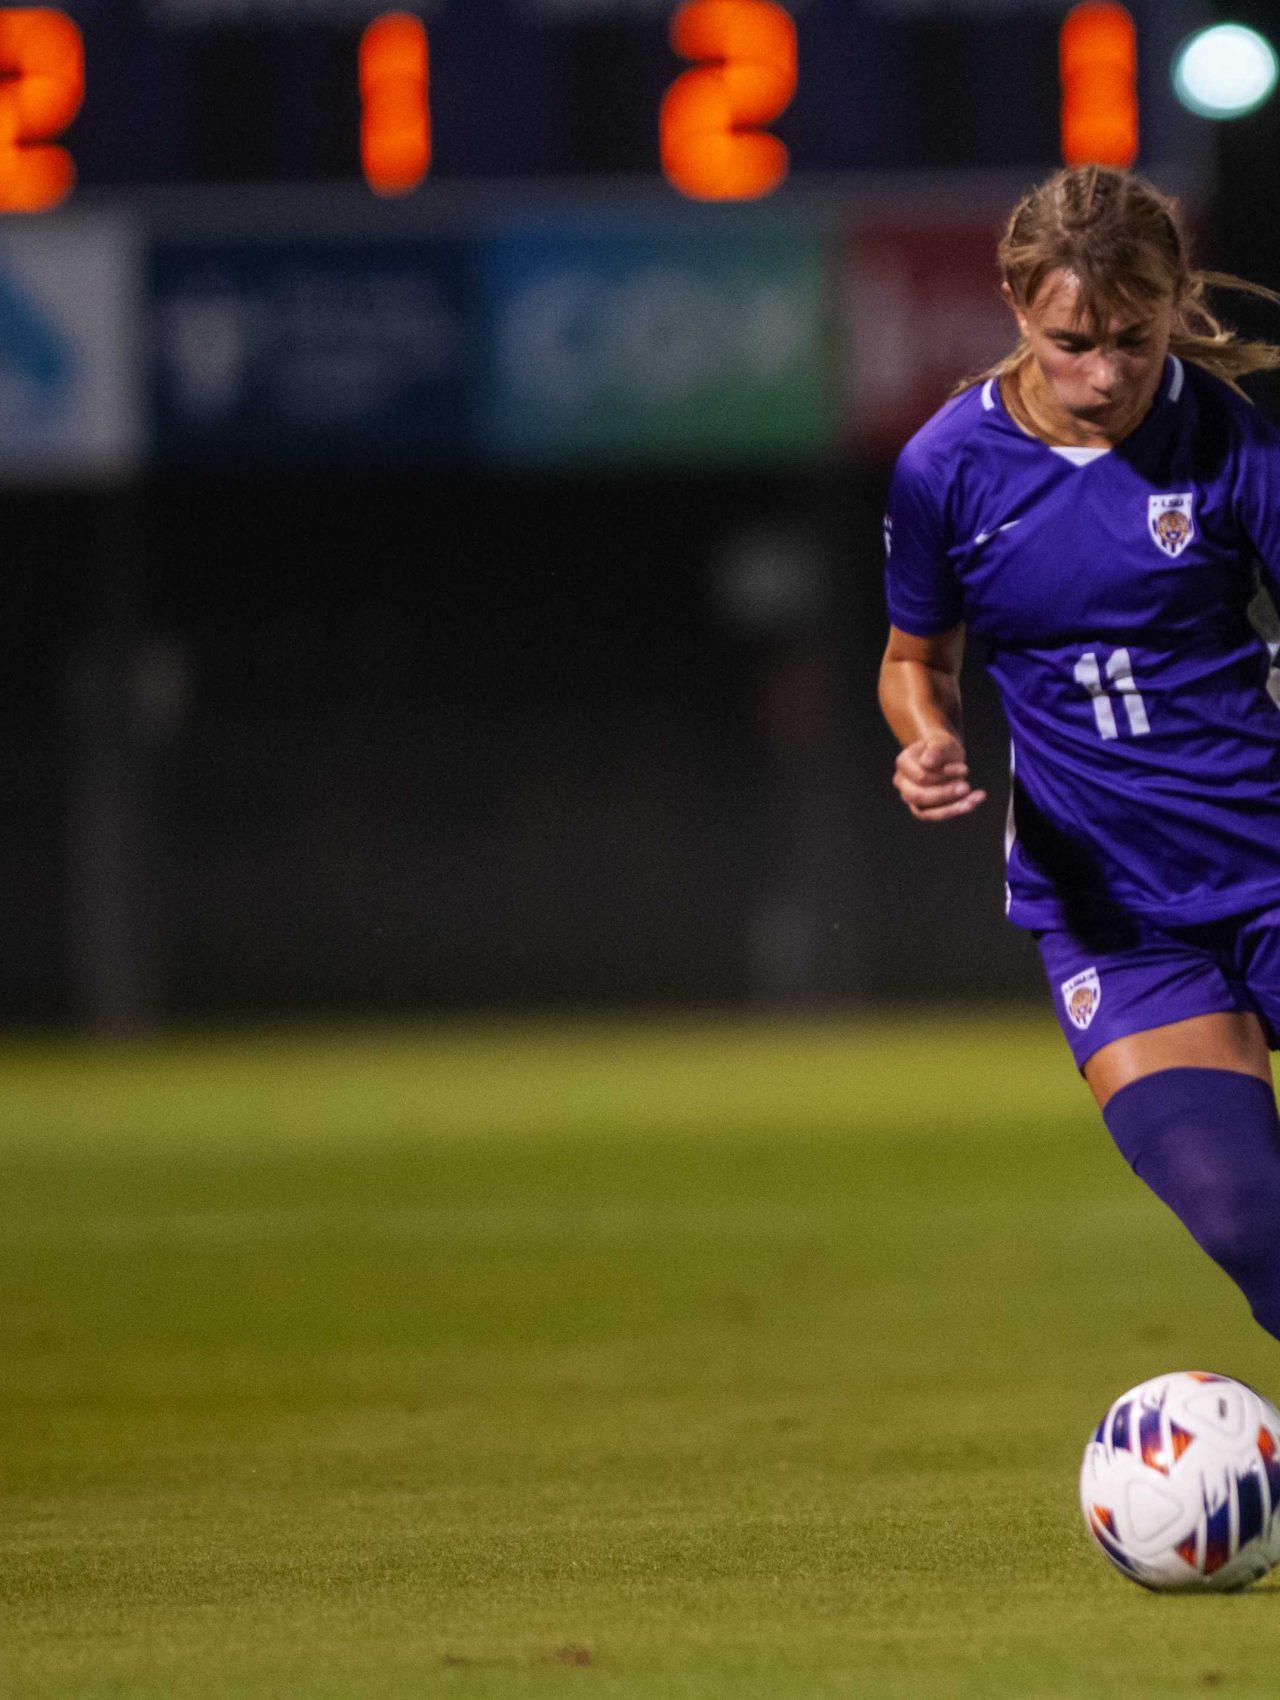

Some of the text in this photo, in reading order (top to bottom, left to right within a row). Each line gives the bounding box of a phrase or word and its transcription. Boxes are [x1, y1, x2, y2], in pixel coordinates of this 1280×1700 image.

[0, 6, 85, 213] 2
[359, 11, 431, 196] 1
[659, 0, 798, 201] 2
[1060, 1, 1139, 170] 1
[1073, 648, 1151, 740] 11
